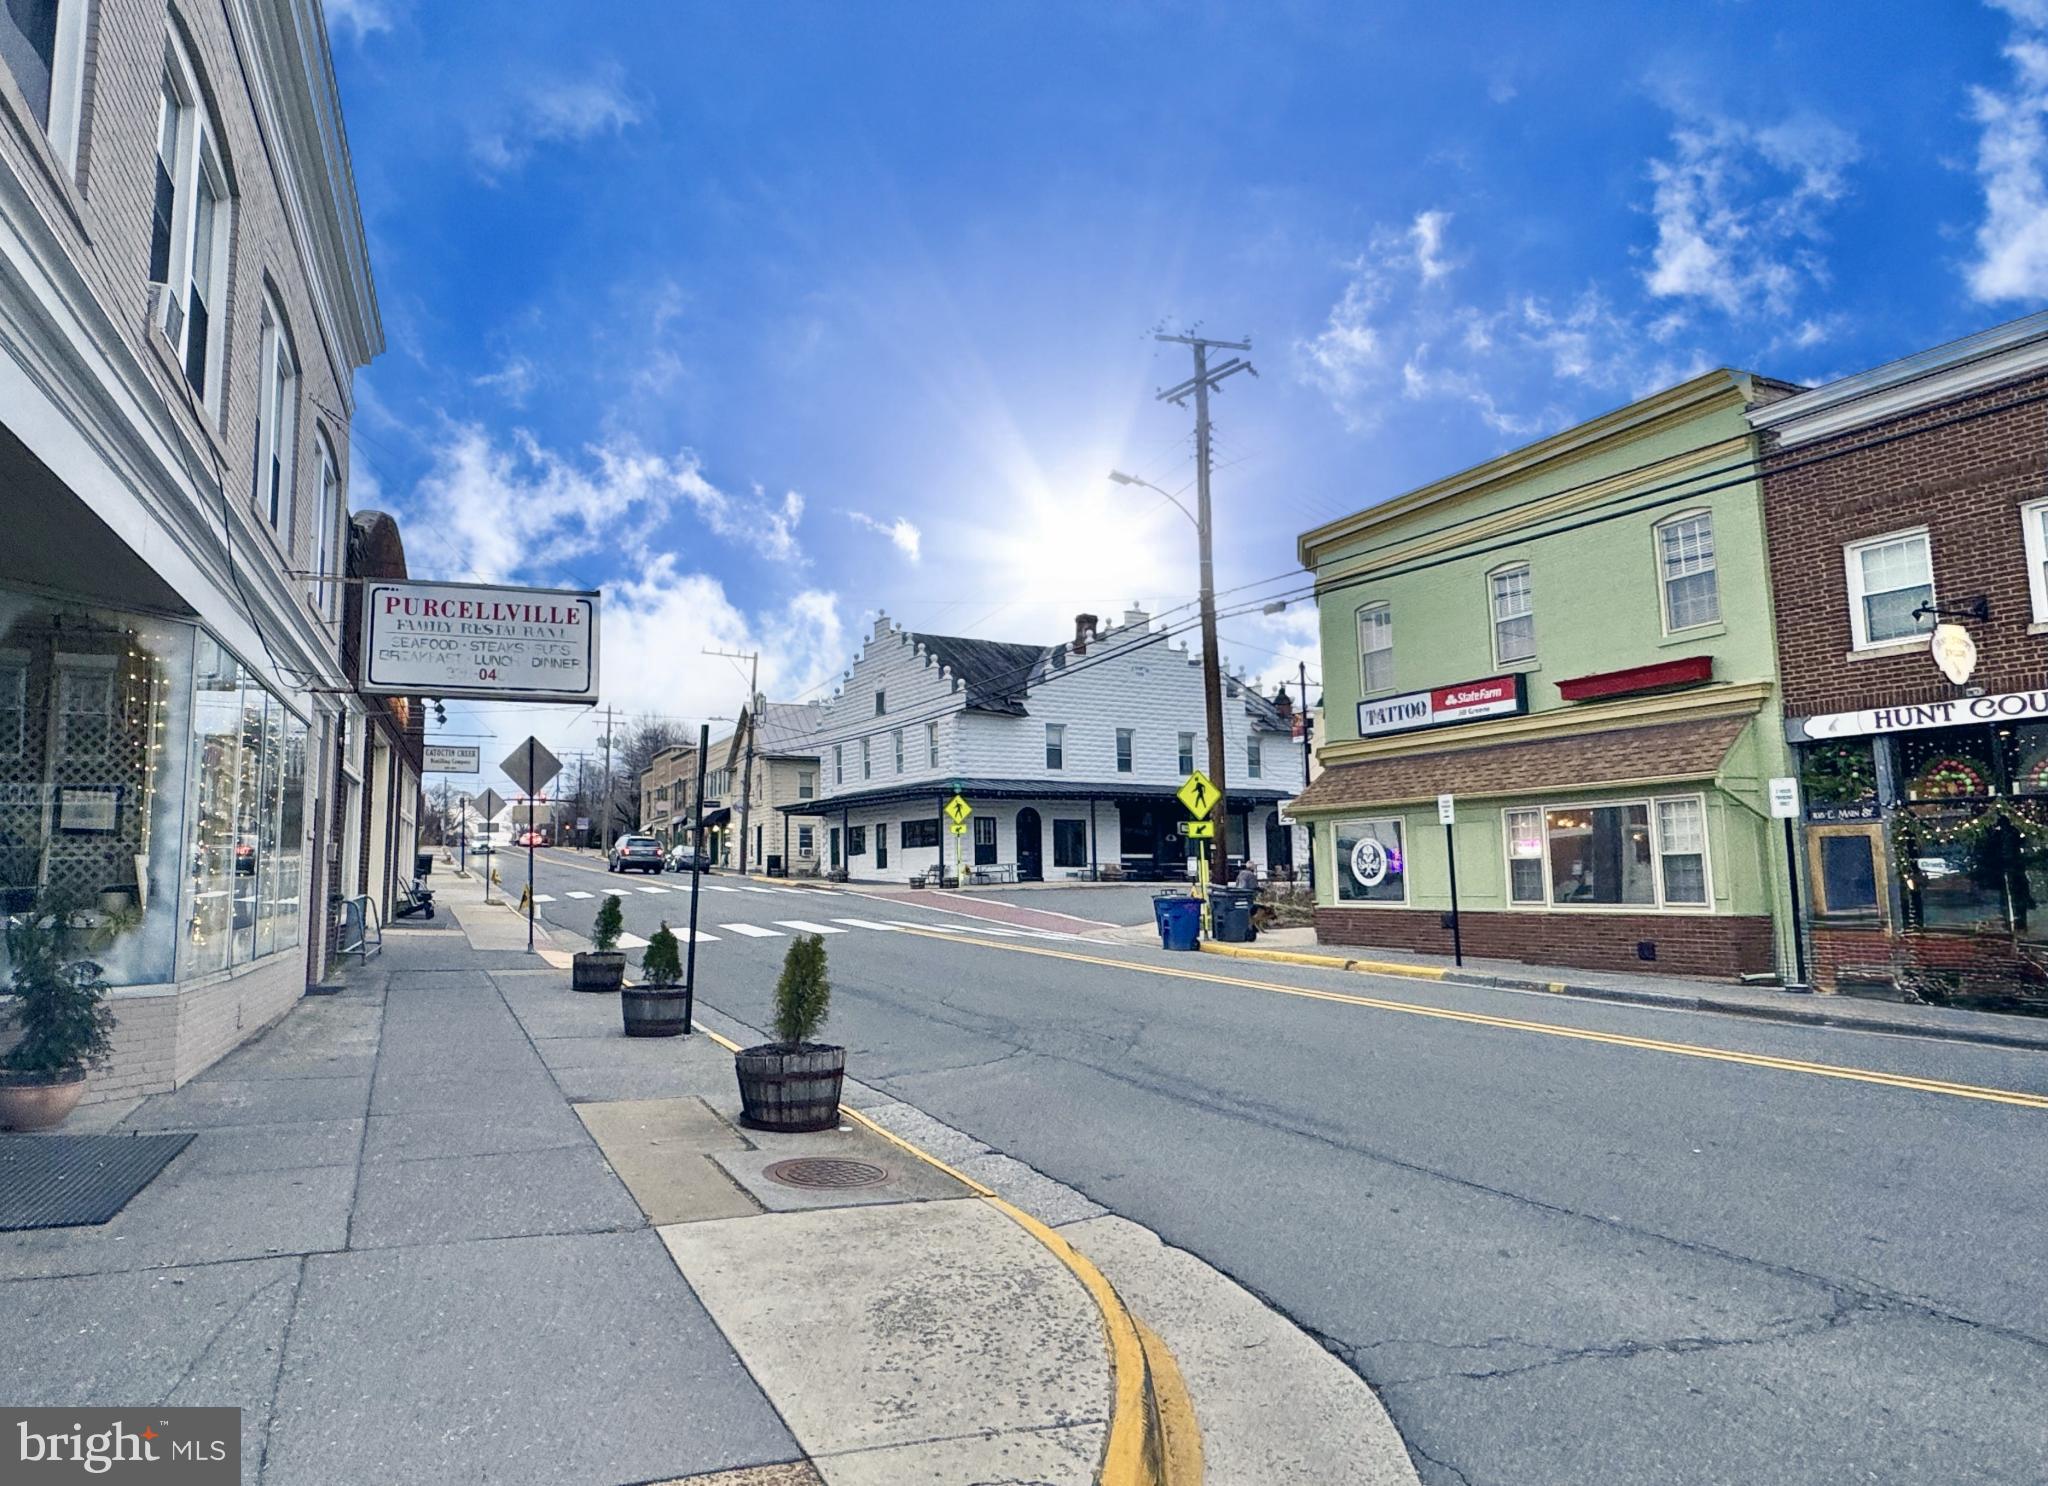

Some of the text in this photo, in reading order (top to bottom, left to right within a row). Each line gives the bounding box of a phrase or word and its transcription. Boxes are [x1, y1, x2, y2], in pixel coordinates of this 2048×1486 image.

[385, 597, 580, 625] PURCELLVILLE
[391, 636, 458, 650] SEAFOOD
[1366, 701, 1427, 726] TATTOO
[1874, 691, 2048, 729] HUNT COU
